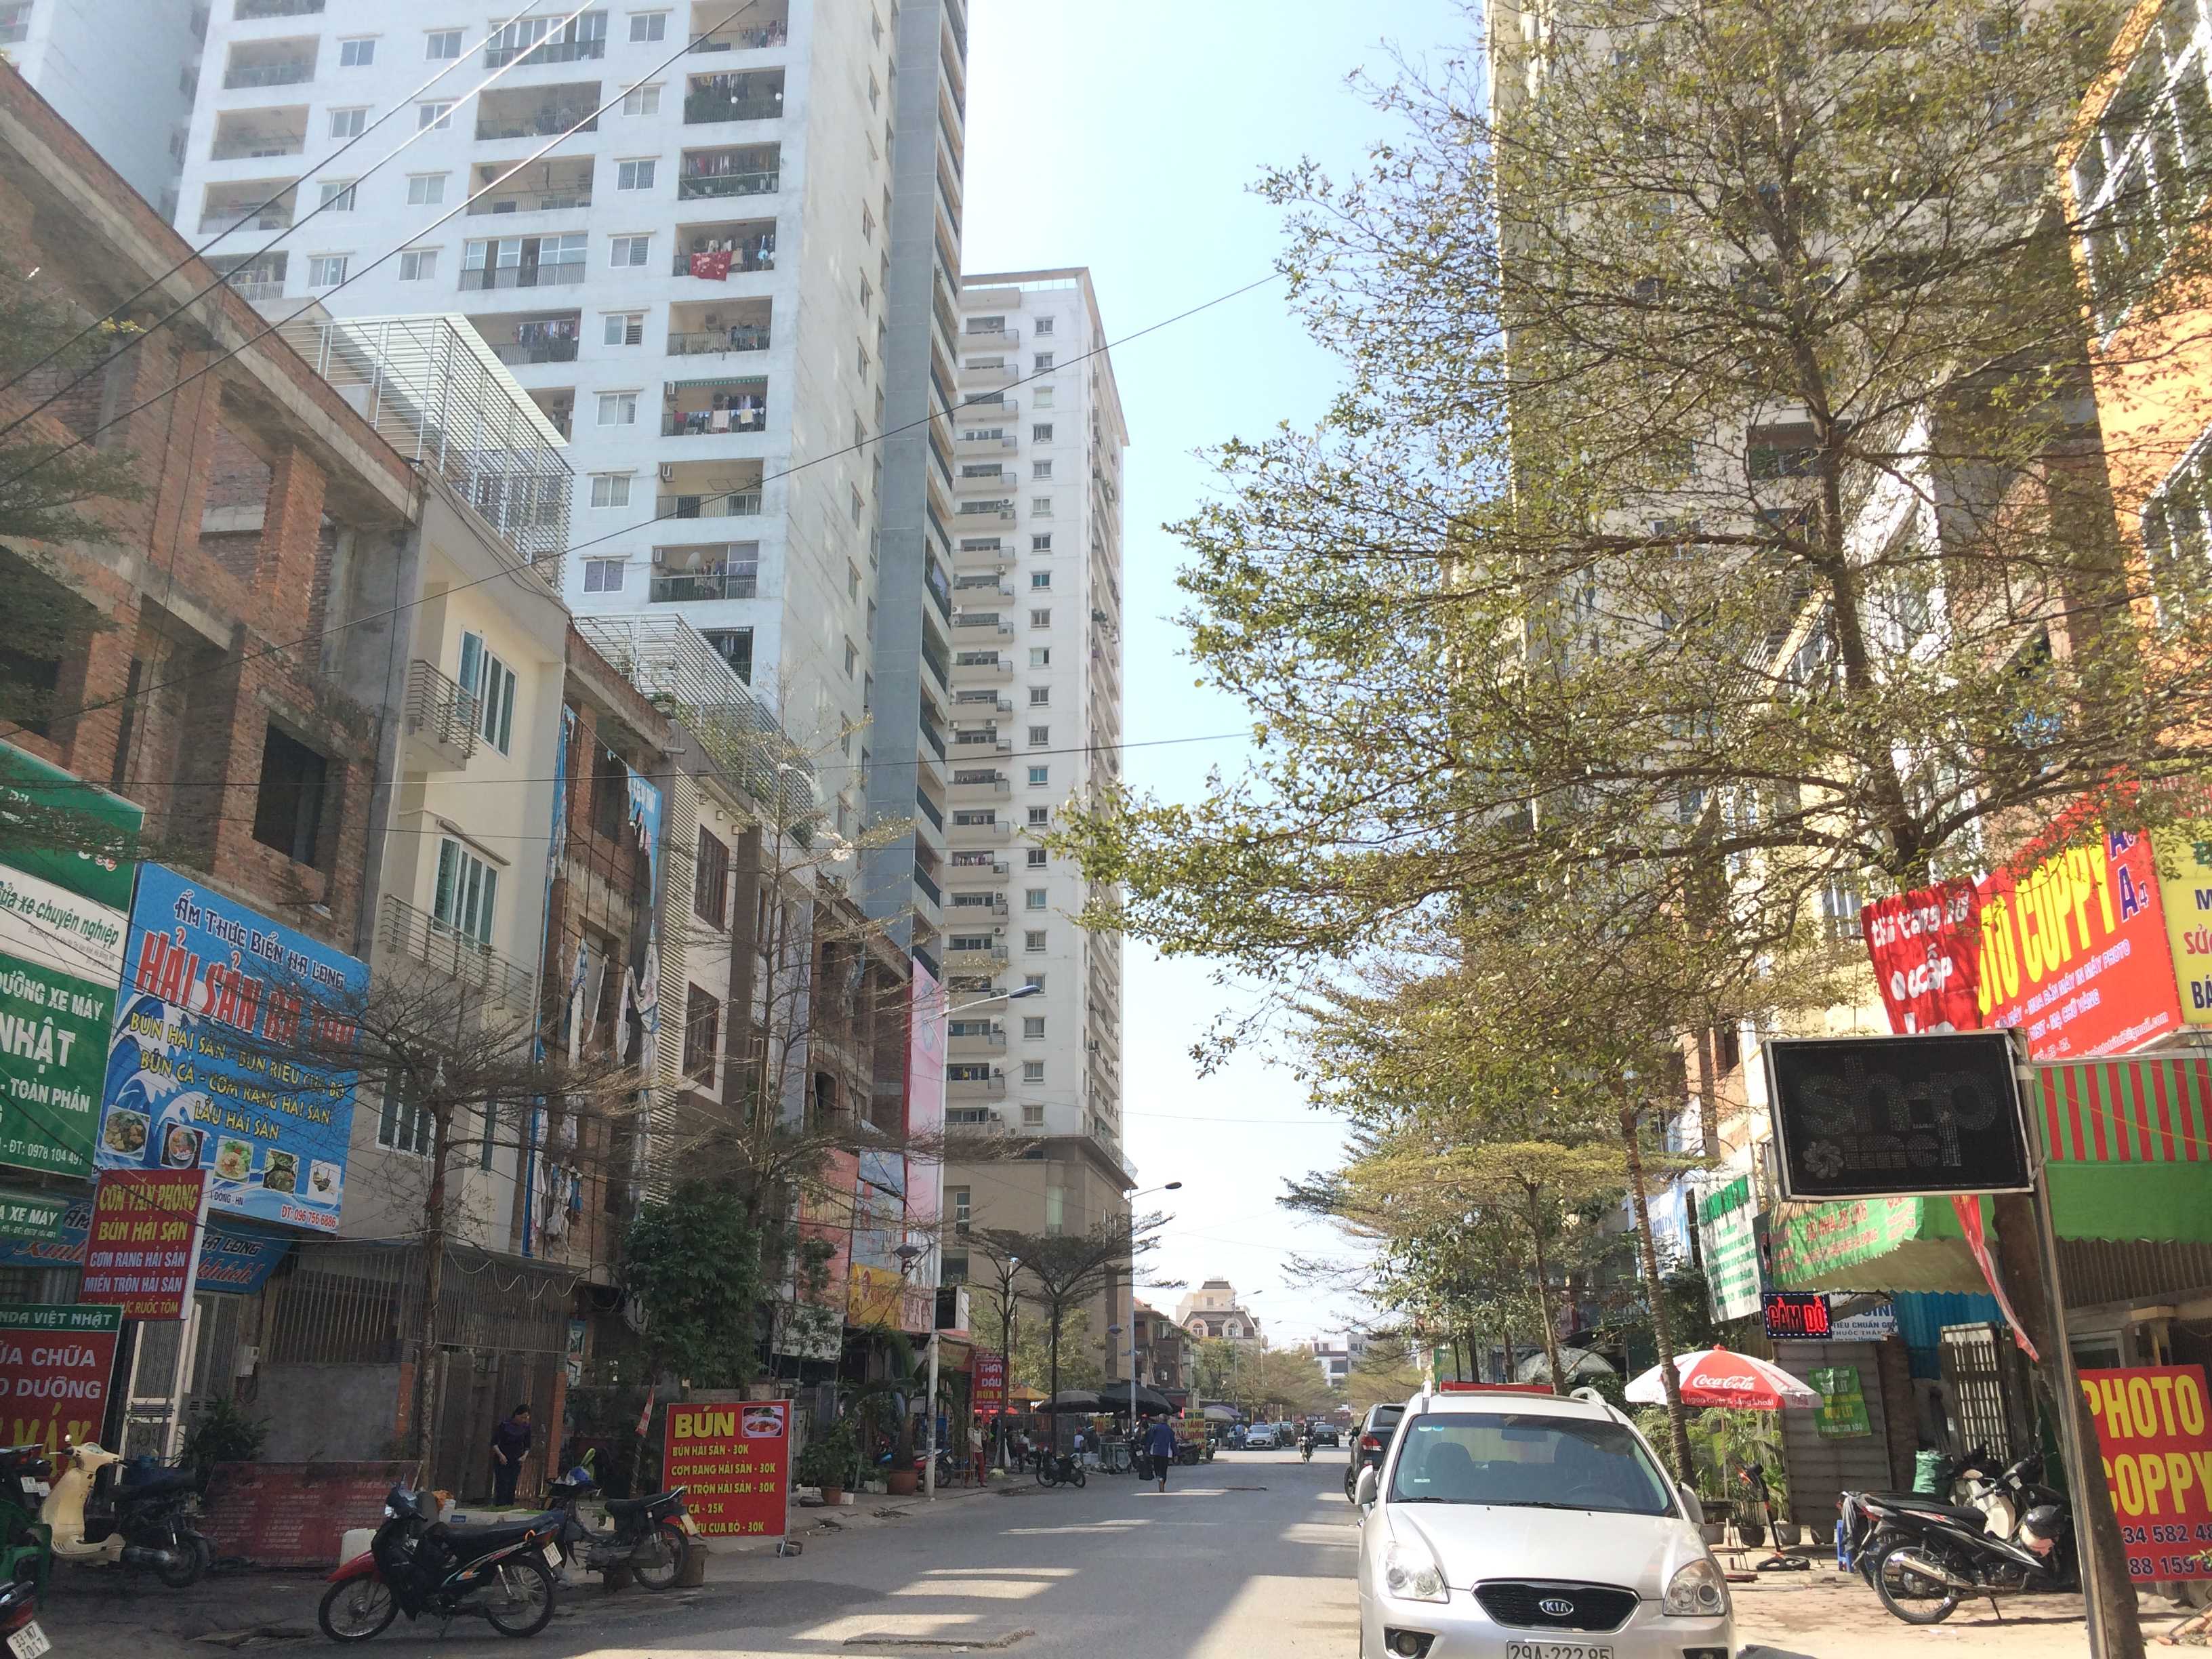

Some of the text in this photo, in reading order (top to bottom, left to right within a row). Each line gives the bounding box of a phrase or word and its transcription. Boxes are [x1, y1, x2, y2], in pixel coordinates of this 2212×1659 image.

[18, 895, 35, 914] xe
[36, 900, 79, 930] chuyên
[80, 918, 119, 949] nghiệp
[2103, 939, 2131, 970] PHOTO
[136, 927, 199, 1008] HẢI
[201, 951, 264, 1033] SẢN
[311, 960, 346, 990] LONG
[47, 987, 68, 1011] XE
[72, 994, 104, 1021] MÁY
[130, 1010, 163, 1040] BÚN
[0, 1012, 76, 1073] NHẬT
[10, 1078, 90, 1113] TOÀN PHẦN
[194, 1095, 281, 1141] LẨU HẢI SẢN
[28, 1143, 48, 1160] 0978
[52, 1148, 66, 1162] 104
[156, 1176, 199, 1211] PHÒNG
[9, 1206, 27, 1222] XE
[28, 1208, 58, 1225] MÁY
[295, 1209, 306, 1221] 096
[308, 1212, 320, 1225] 756
[321, 1214, 337, 1228] 6886
[98, 1217, 128, 1240] BÚN
[131, 1216, 158, 1242] HẢI
[89, 1246, 186, 1267] CƠM RANG HẢI SẢN
[84, 1271, 183, 1296] MIẾN TRỘN HẢI SẢN
[35, 1309, 67, 1327] VIỆT
[71, 1309, 112, 1328] NHẬT
[160, 1300, 178, 1313] TÔM
[1767, 1296, 1801, 1332] CẦM
[32, 1344, 96, 1368] CHỮA
[16, 1374, 102, 1399] DƯỠNG
[1692, 1374, 1756, 1389] Coca-Cola
[2081, 1374, 2205, 1439] PHOTO
[674, 1406, 735, 1438] BÚN
[672, 1442, 749, 1457] BÚN HẢI SẢN 30K
[671, 1460, 775, 1476] CƠM RANG HẢI SẢN 30K
[693, 1482, 716, 1496] TRỘN
[718, 1480, 732, 1494] HẢI
[734, 1480, 752, 1493] SẢN
[759, 1482, 775, 1492] 30K
[708, 1503, 724, 1513] 25K
[708, 1523, 726, 1533] CUA
[747, 1522, 764, 1532] 30K
[2153, 1525, 2188, 1543] 582
[2160, 1557, 2195, 1574] 159
[1546, 1602, 1569, 1612] KIA
